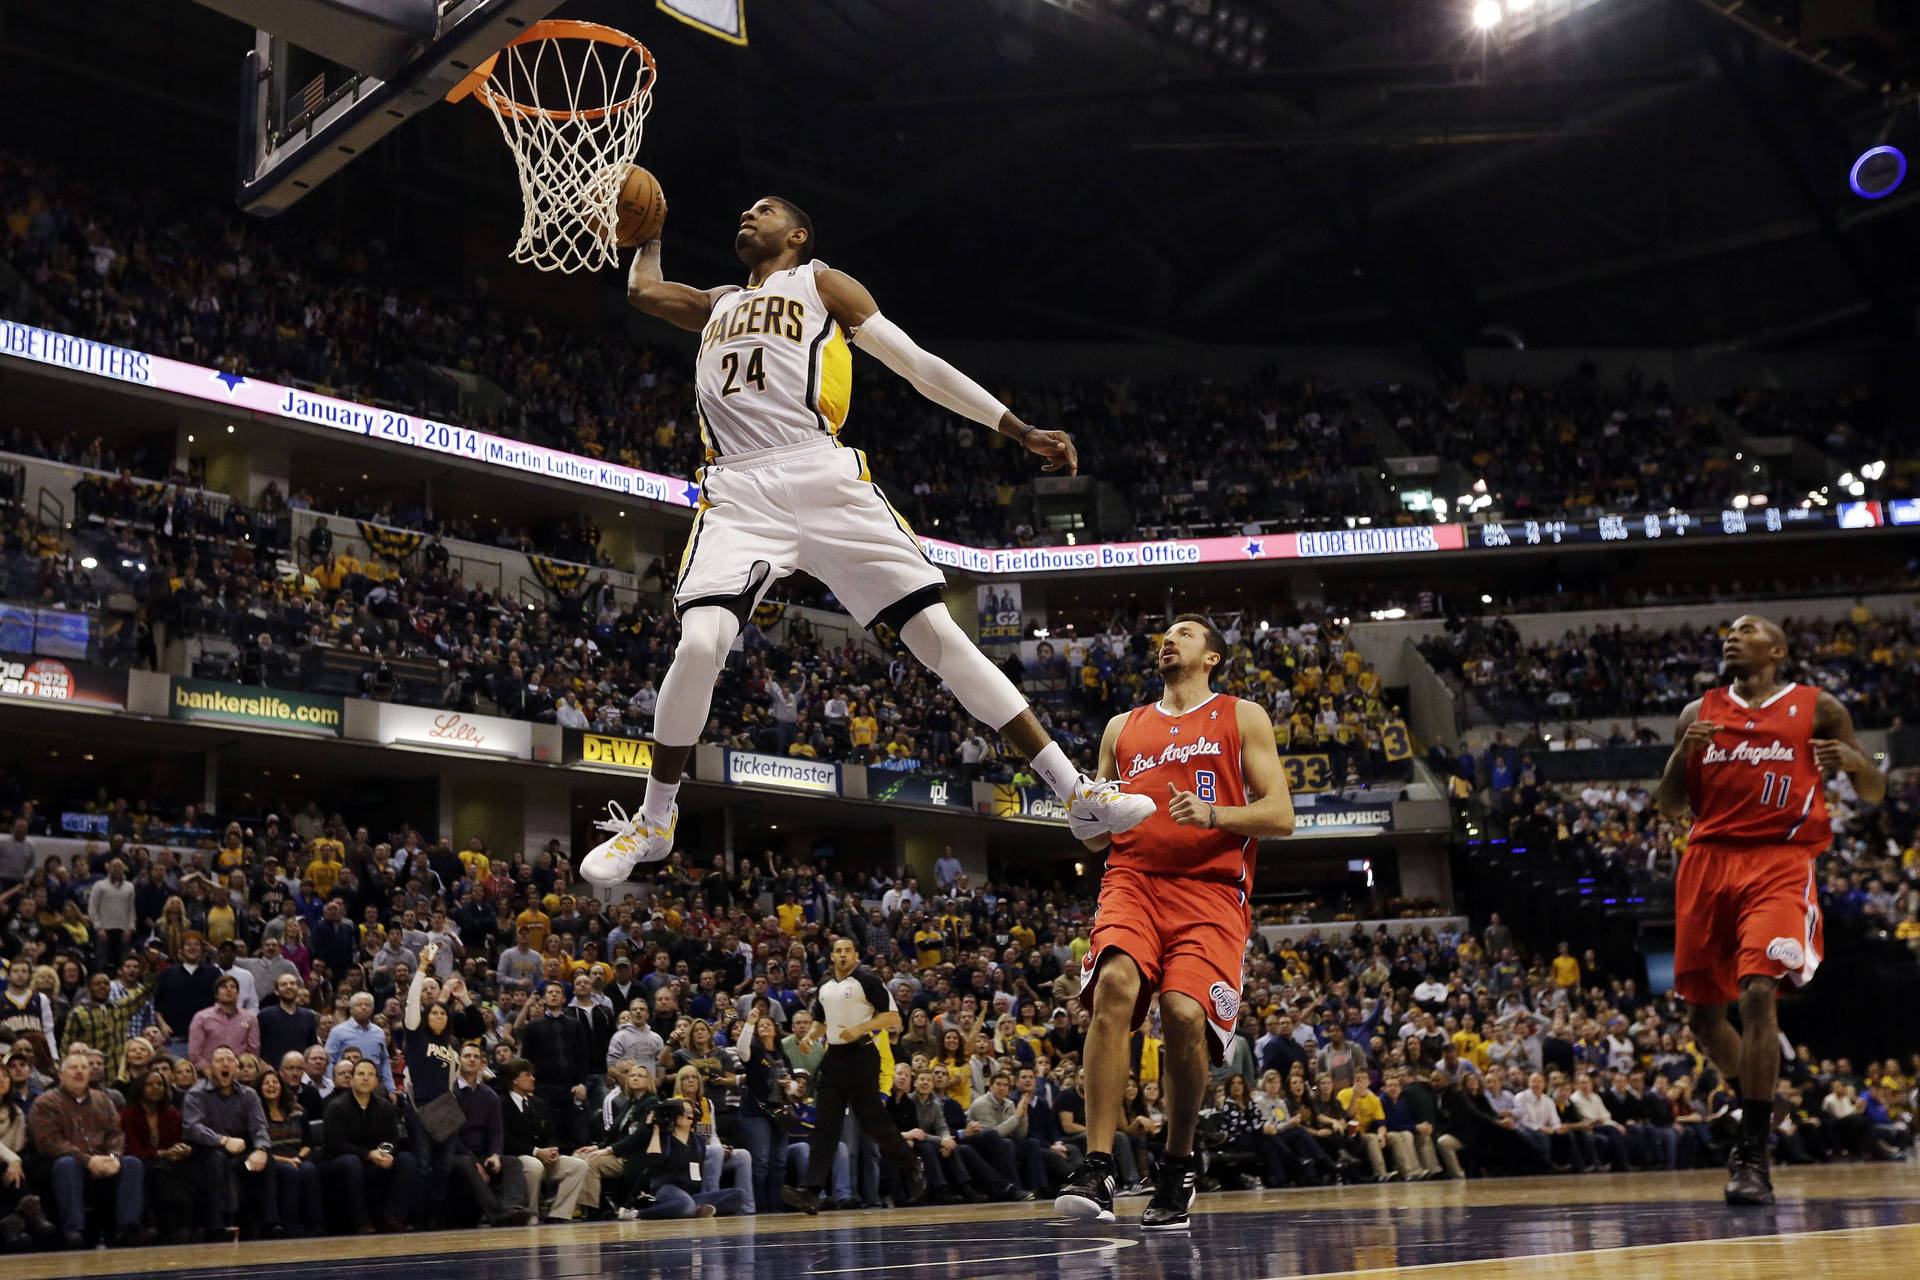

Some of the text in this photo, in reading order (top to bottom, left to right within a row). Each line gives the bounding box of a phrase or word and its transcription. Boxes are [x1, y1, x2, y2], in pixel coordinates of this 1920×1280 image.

[701, 296, 805, 353] PACERS
[721, 346, 766, 398] 24
[282, 392, 667, 501] January 20, 2014 (Martin Luther King Day)
[962, 550, 988, 570] Life
[996, 549, 1095, 571] Fieldhouse
[1102, 548, 1136, 565] Box
[1142, 544, 1198, 563] Office
[1299, 526, 1433, 555] GLOBETROTTERS
[996, 611, 1020, 626] G2
[176, 686, 339, 725] bankerslife.com
[429, 713, 485, 747] Lilly
[733, 755, 835, 785] ticketmaster
[1129, 736, 1221, 777] Los Angeles
[1702, 740, 1795, 766] Los Angeles
[1196, 769, 1217, 803] 8
[1284, 757, 1328, 791] 33
[1760, 771, 1792, 809] 11
[1316, 810, 1391, 826] GRAPHICS
